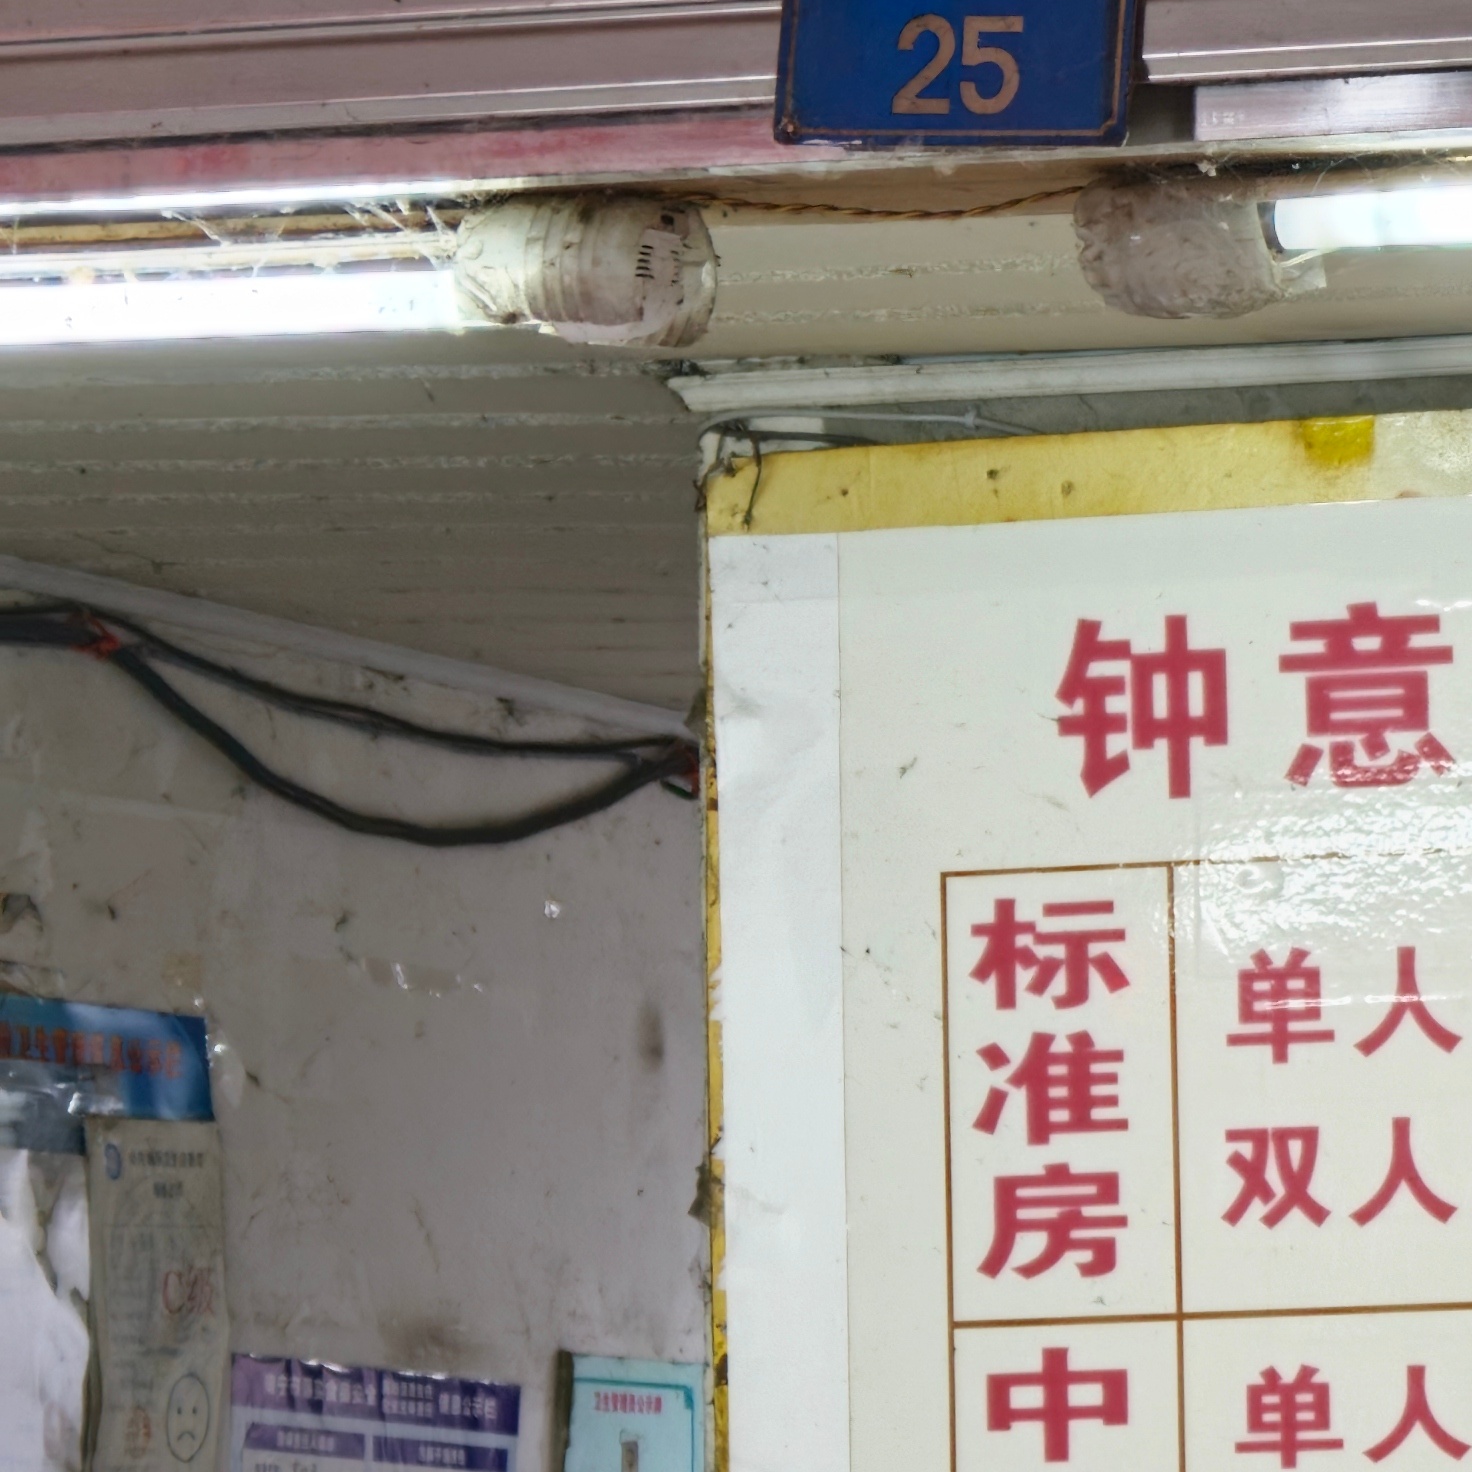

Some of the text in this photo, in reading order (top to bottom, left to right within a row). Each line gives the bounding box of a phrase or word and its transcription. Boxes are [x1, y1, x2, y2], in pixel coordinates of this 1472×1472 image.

[891, 12, 1025, 116] 25
[970, 897, 1131, 1282] 标准房
